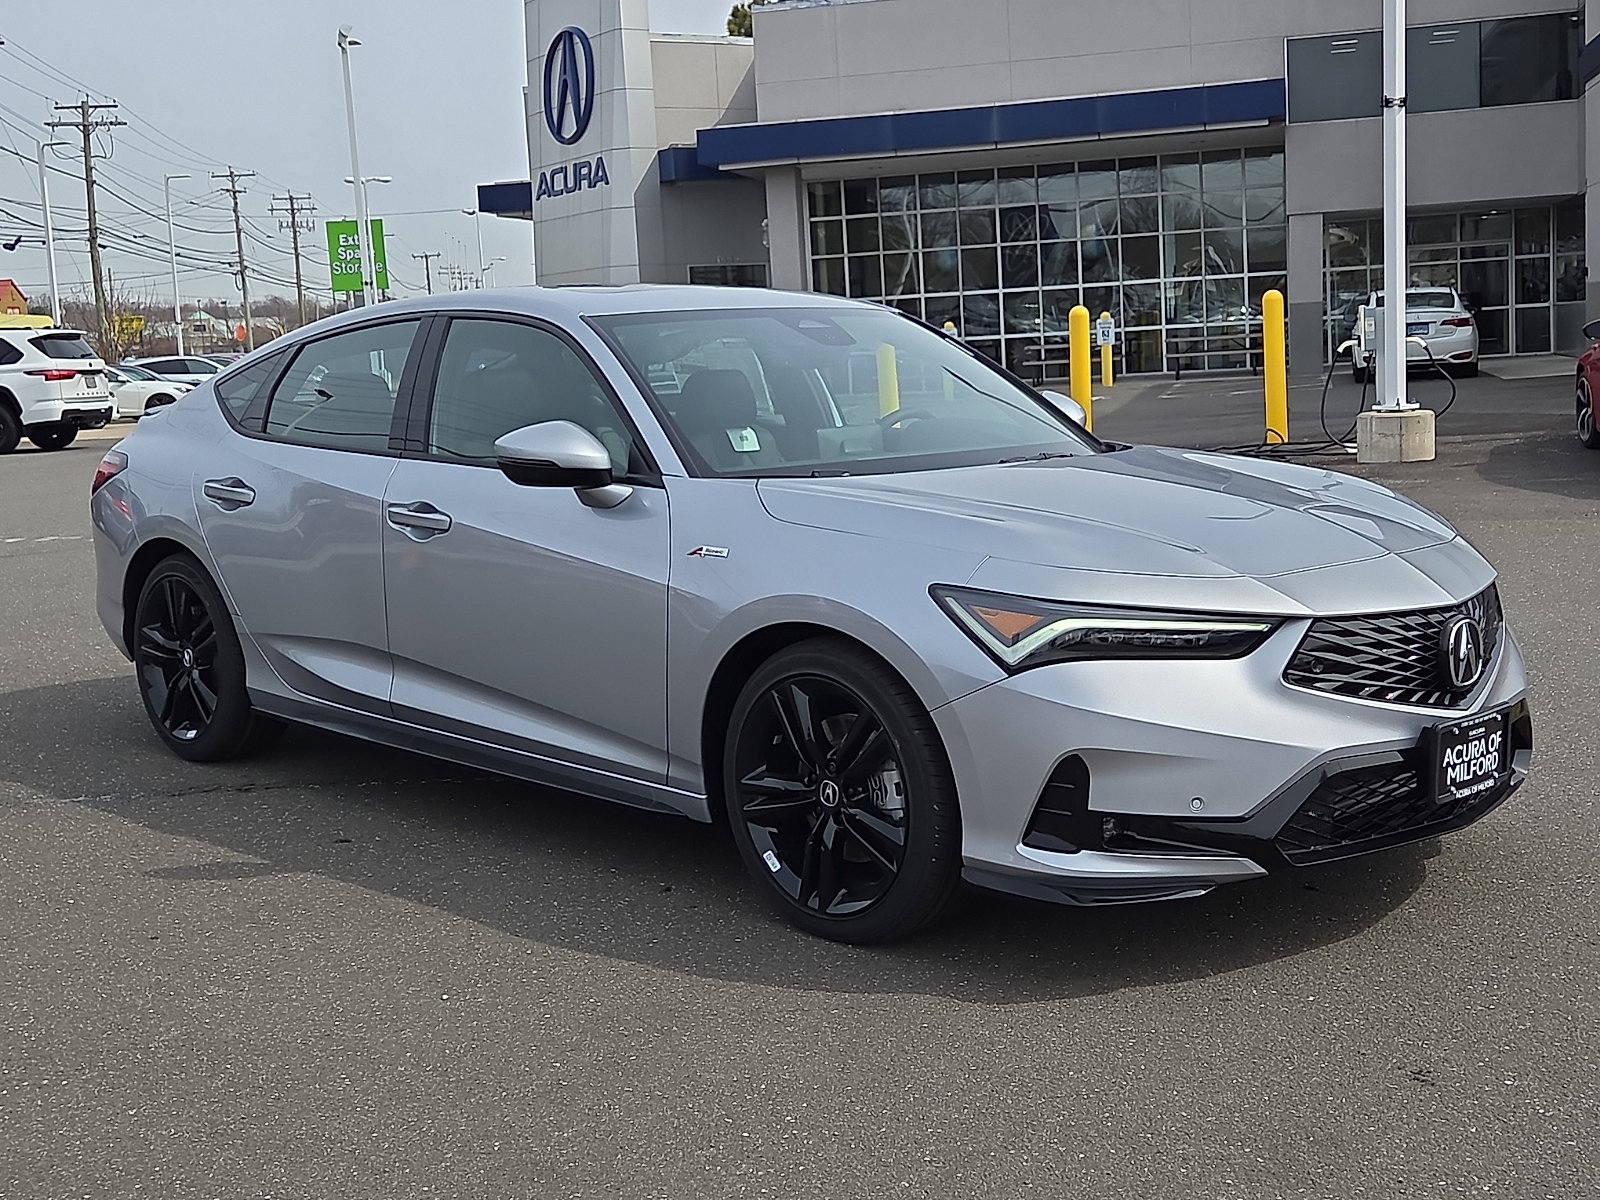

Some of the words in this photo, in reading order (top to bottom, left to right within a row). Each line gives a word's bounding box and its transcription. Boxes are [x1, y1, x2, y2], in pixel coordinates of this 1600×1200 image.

[536, 156, 610, 201] ACURA
[339, 233, 360, 246] Ext
[332, 261, 383, 275] Store
[1442, 738, 1487, 768] ACURA
[1488, 730, 1503, 752] OF
[1446, 751, 1499, 785] MILFORD
